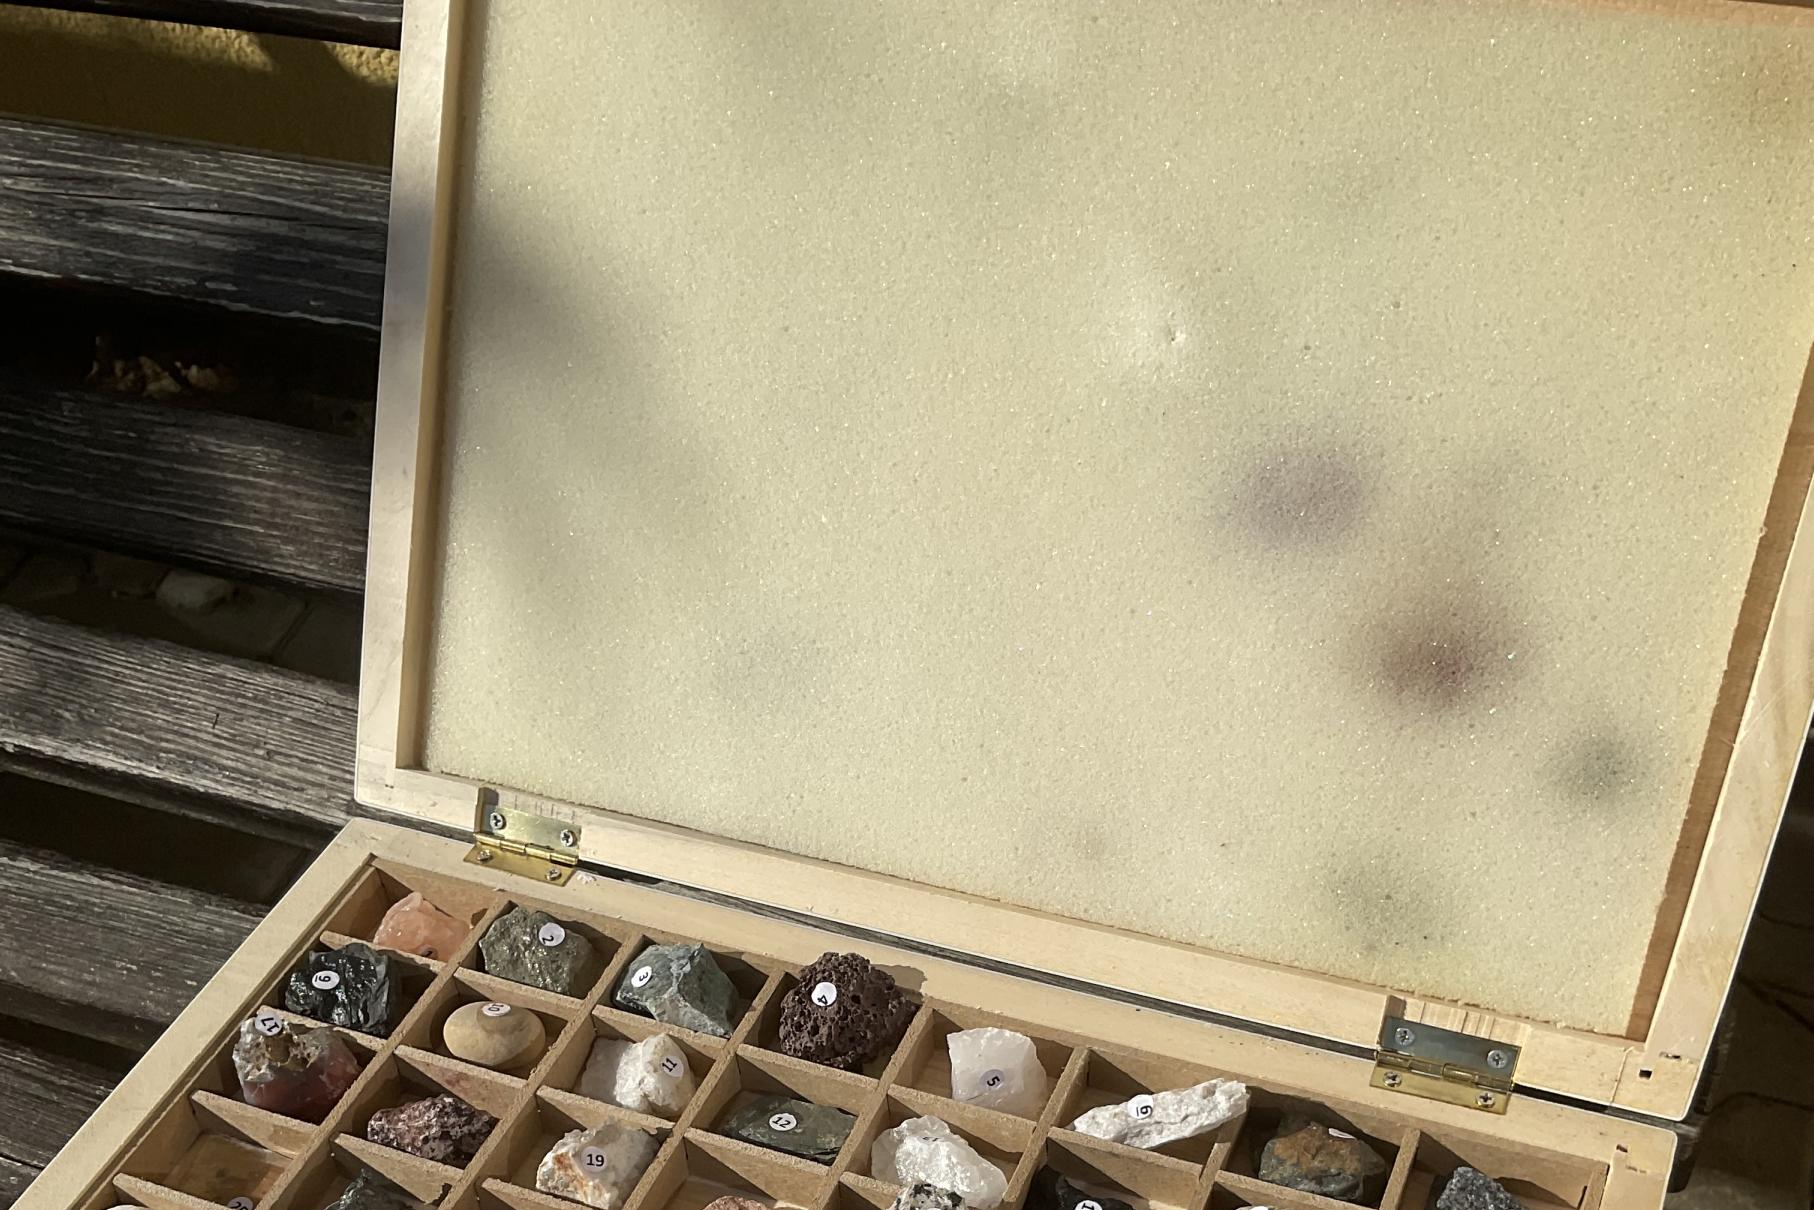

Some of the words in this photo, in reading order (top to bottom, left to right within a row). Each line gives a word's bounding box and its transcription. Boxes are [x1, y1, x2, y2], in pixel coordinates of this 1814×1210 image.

[540, 933, 554, 945] 2
[314, 973, 331, 984] 9
[638, 972, 649, 983] 3
[817, 994, 829, 1005] 4
[260, 1014, 280, 1032] 17
[661, 1057, 678, 1073] 11
[986, 1075, 1000, 1088] 5
[1135, 1103, 1152, 1117] 6
[770, 1115, 792, 1128] 12
[584, 1152, 605, 1168] 19
